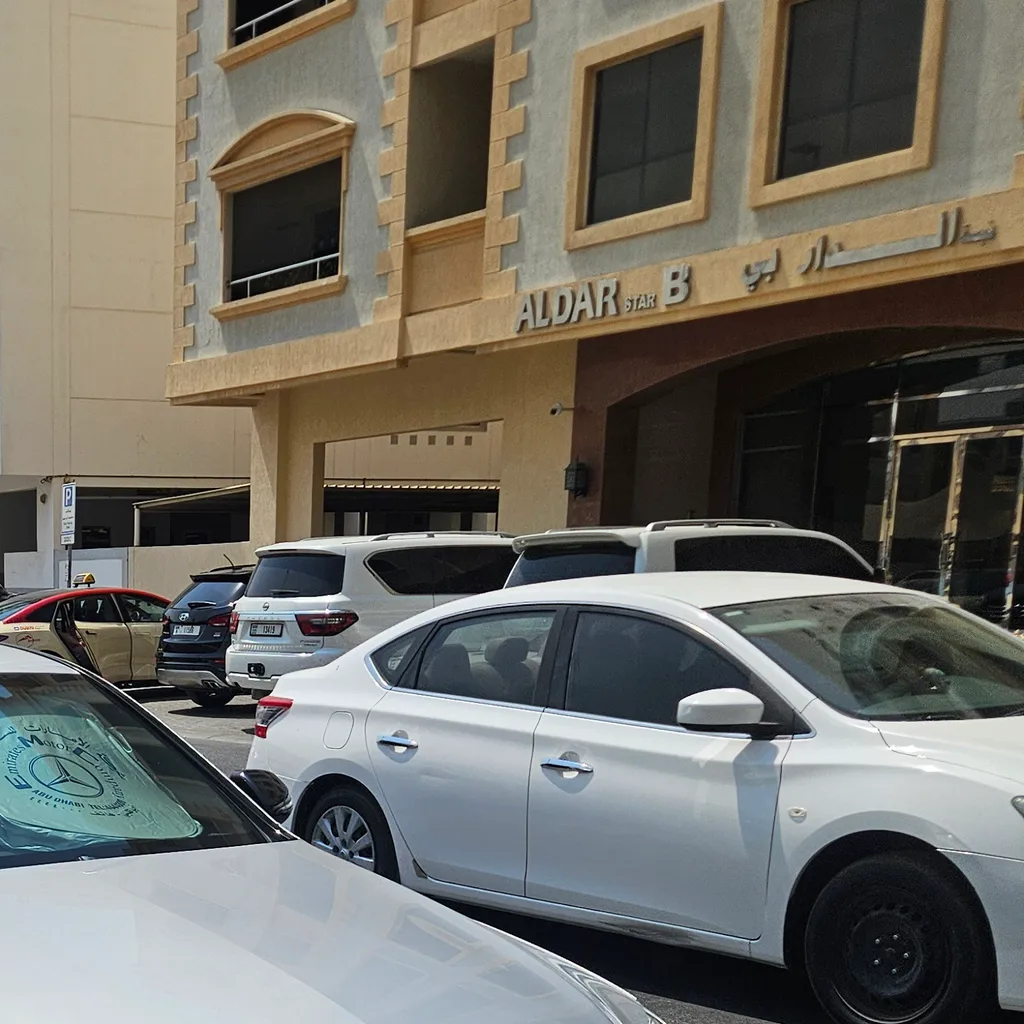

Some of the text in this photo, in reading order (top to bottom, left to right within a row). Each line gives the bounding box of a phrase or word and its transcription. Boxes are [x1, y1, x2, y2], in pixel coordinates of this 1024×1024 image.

[797, 207, 962, 275] الدار
[740, 248, 780, 292] بي
[514, 264, 691, 332] ALDAR STAR B
[17, 735, 72, 751] Motor
[4, 745, 33, 789] Emirates
